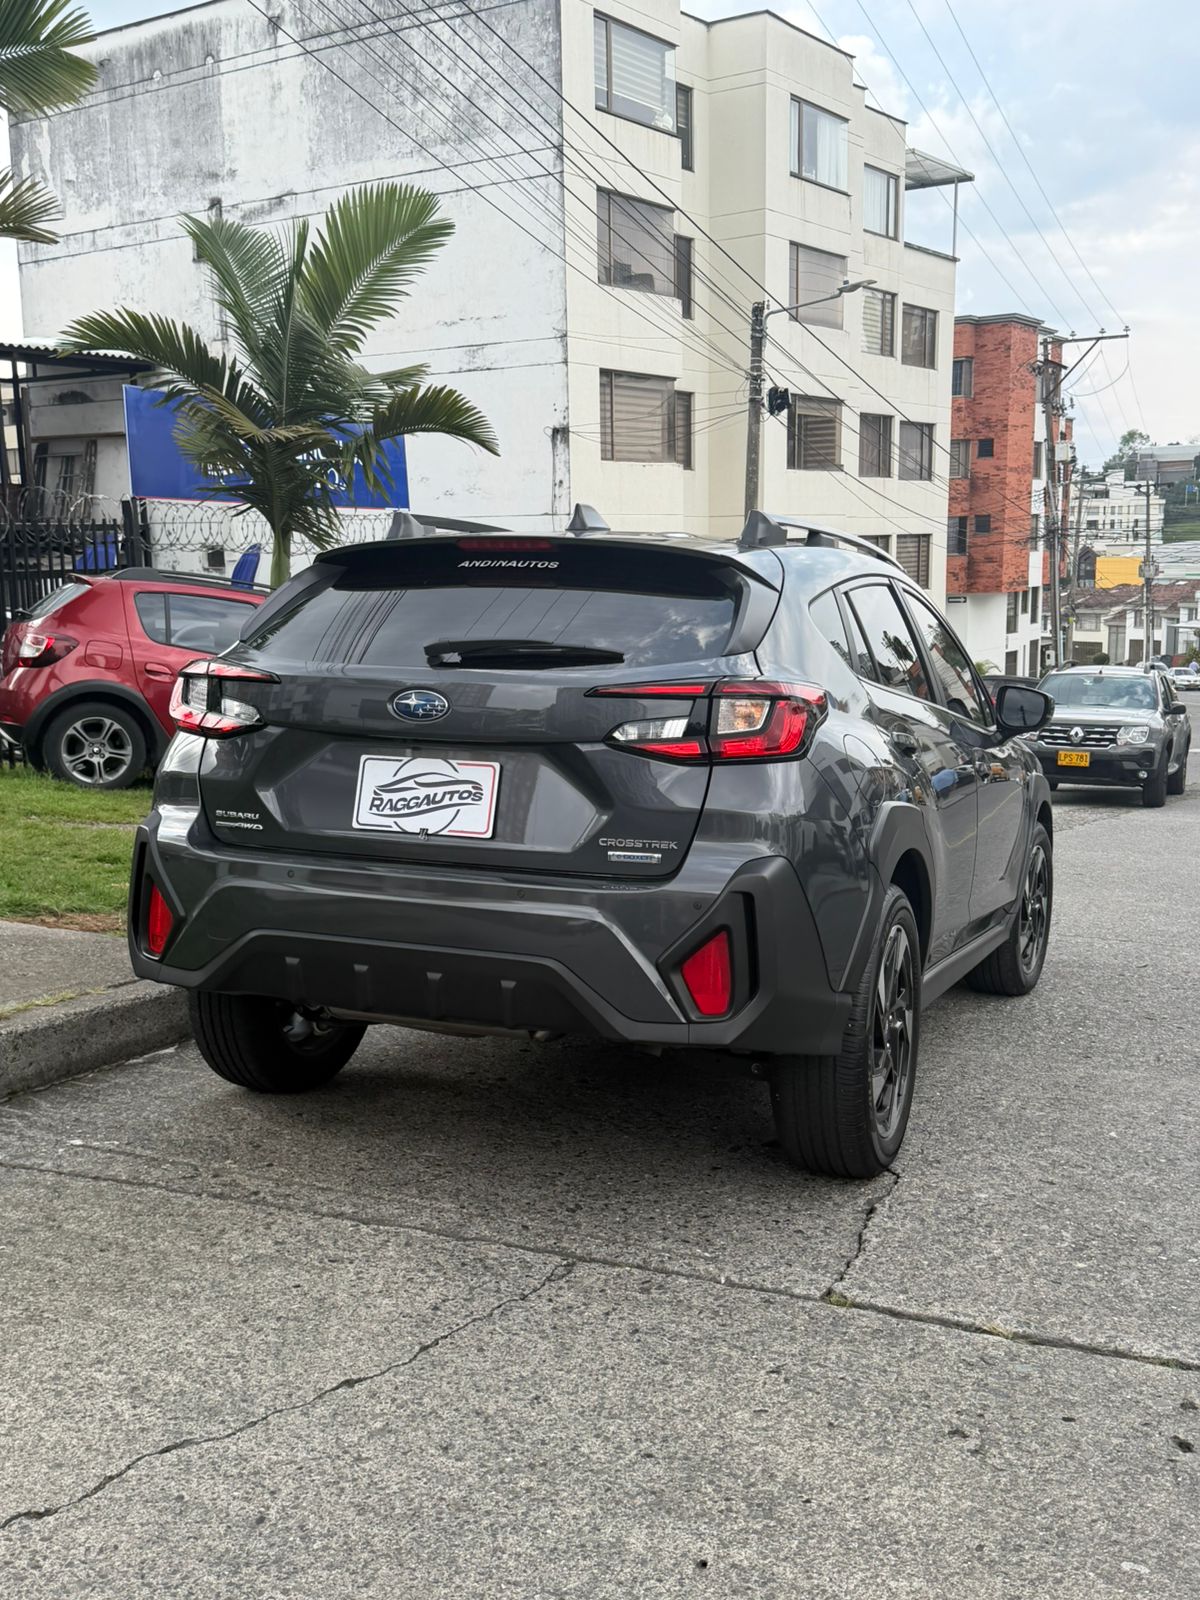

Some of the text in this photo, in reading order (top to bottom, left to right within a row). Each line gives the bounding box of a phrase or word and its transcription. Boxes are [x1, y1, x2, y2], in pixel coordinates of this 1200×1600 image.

[457, 560, 560, 569] ANDINAUTOS
[1059, 753, 1088, 762] LPS 781
[369, 789, 484, 812] RAGGAUTOS
[215, 810, 260, 820] SUBARU
[598, 838, 678, 849] CROSSTREK
